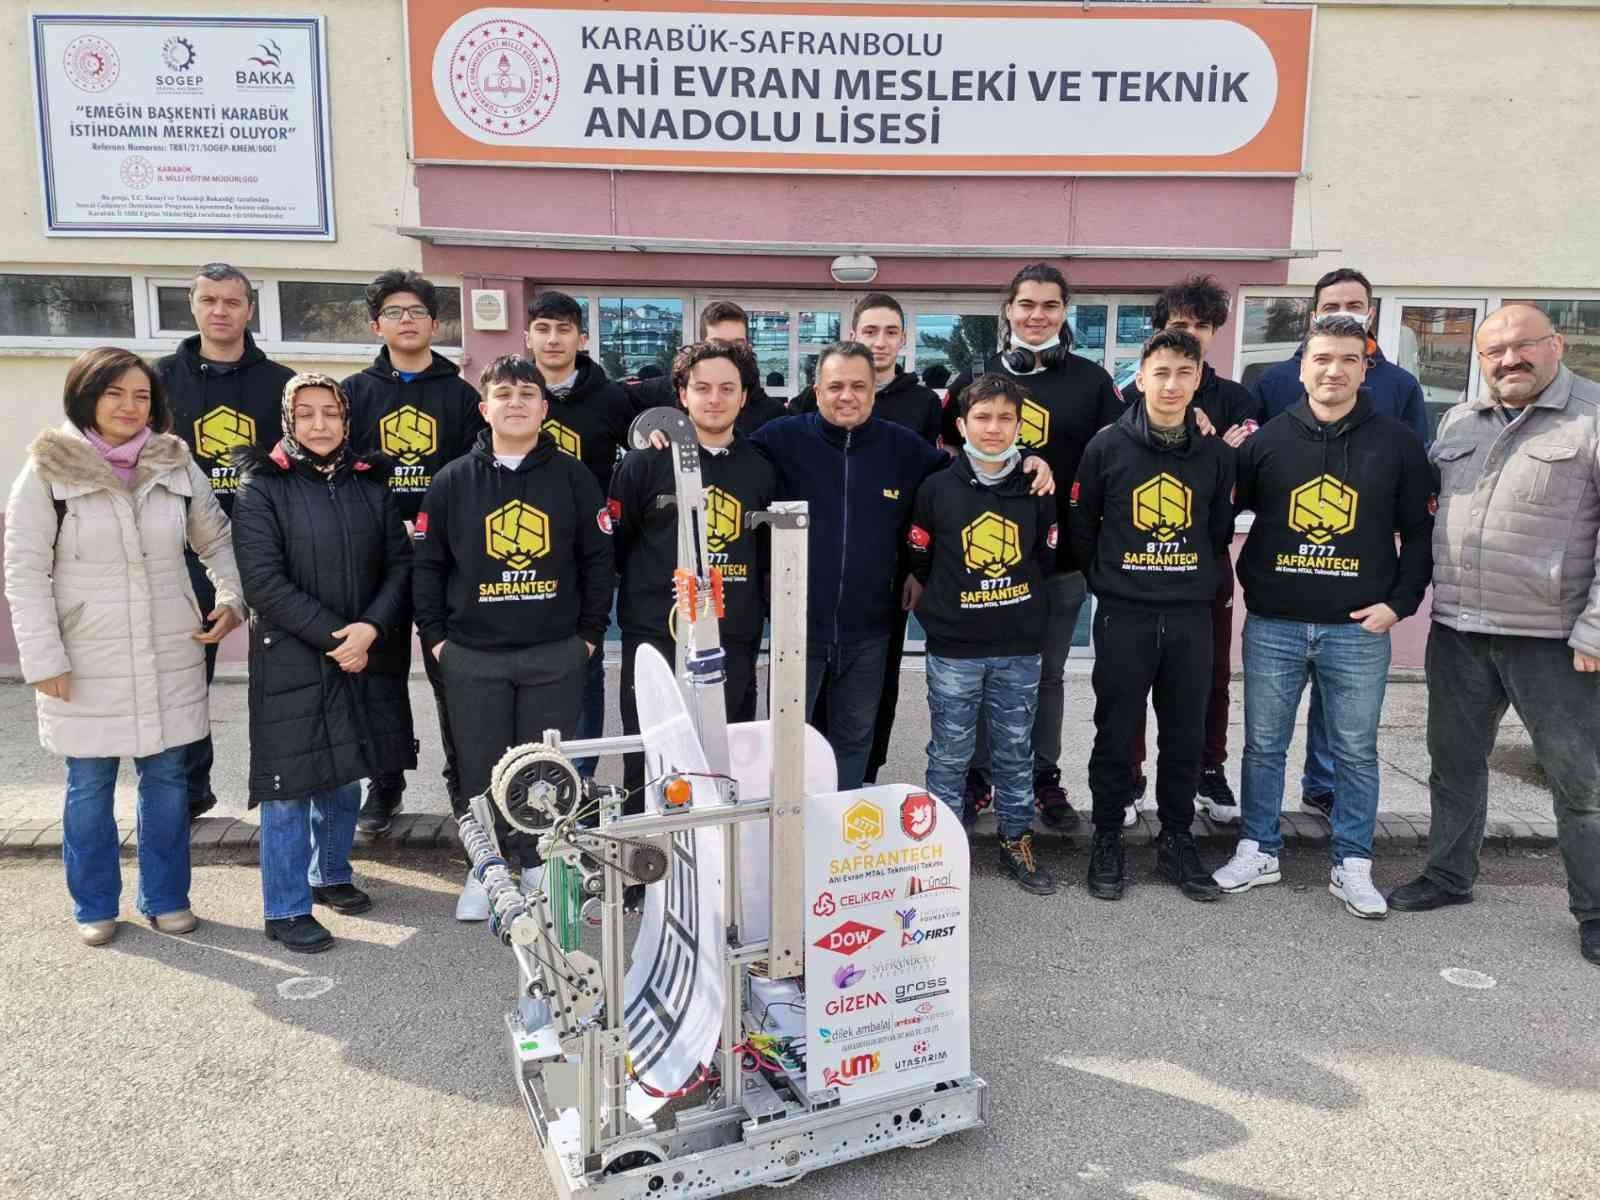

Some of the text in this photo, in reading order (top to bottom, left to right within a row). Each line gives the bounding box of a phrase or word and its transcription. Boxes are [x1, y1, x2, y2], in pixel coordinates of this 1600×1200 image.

[581, 24, 944, 57] KARABÜK-SAFRANBOLU
[156, 75, 204, 86] SOGEP
[235, 71, 295, 86] BAKKA
[583, 57, 1250, 104] AHİ EVRAN MESLEKİ VE TEKNİK
[148, 104, 217, 122] BAŞKENTİ
[221, 105, 289, 121] KARABÜK
[163, 122, 225, 139] MERKEZİ
[583, 104, 940, 145] ANADOLU LİSESİ
[212, 467, 237, 478] 877
[394, 466, 425, 476] 8777
[388, 476, 432, 487] FRANTE
[1146, 542, 1180, 553] 8777
[1298, 544, 1336, 556] 8777
[1123, 552, 1198, 565] SAFRANTECH
[1276, 554, 1360, 570] SAFRANTECH
[502, 570, 536, 581] 8777
[981, 576, 1011, 590] 8777
[479, 580, 558, 596] SAFRANTECH
[960, 582, 1029, 602] SAFRANTECH
[830, 843, 944, 875] SAFRANTECH
[830, 929, 872, 949] DOW
[925, 926, 956, 940] FIRST
[895, 977, 947, 998] gross
[825, 991, 888, 1016] GİZEM
[895, 1051, 948, 1070] UTASARIM
